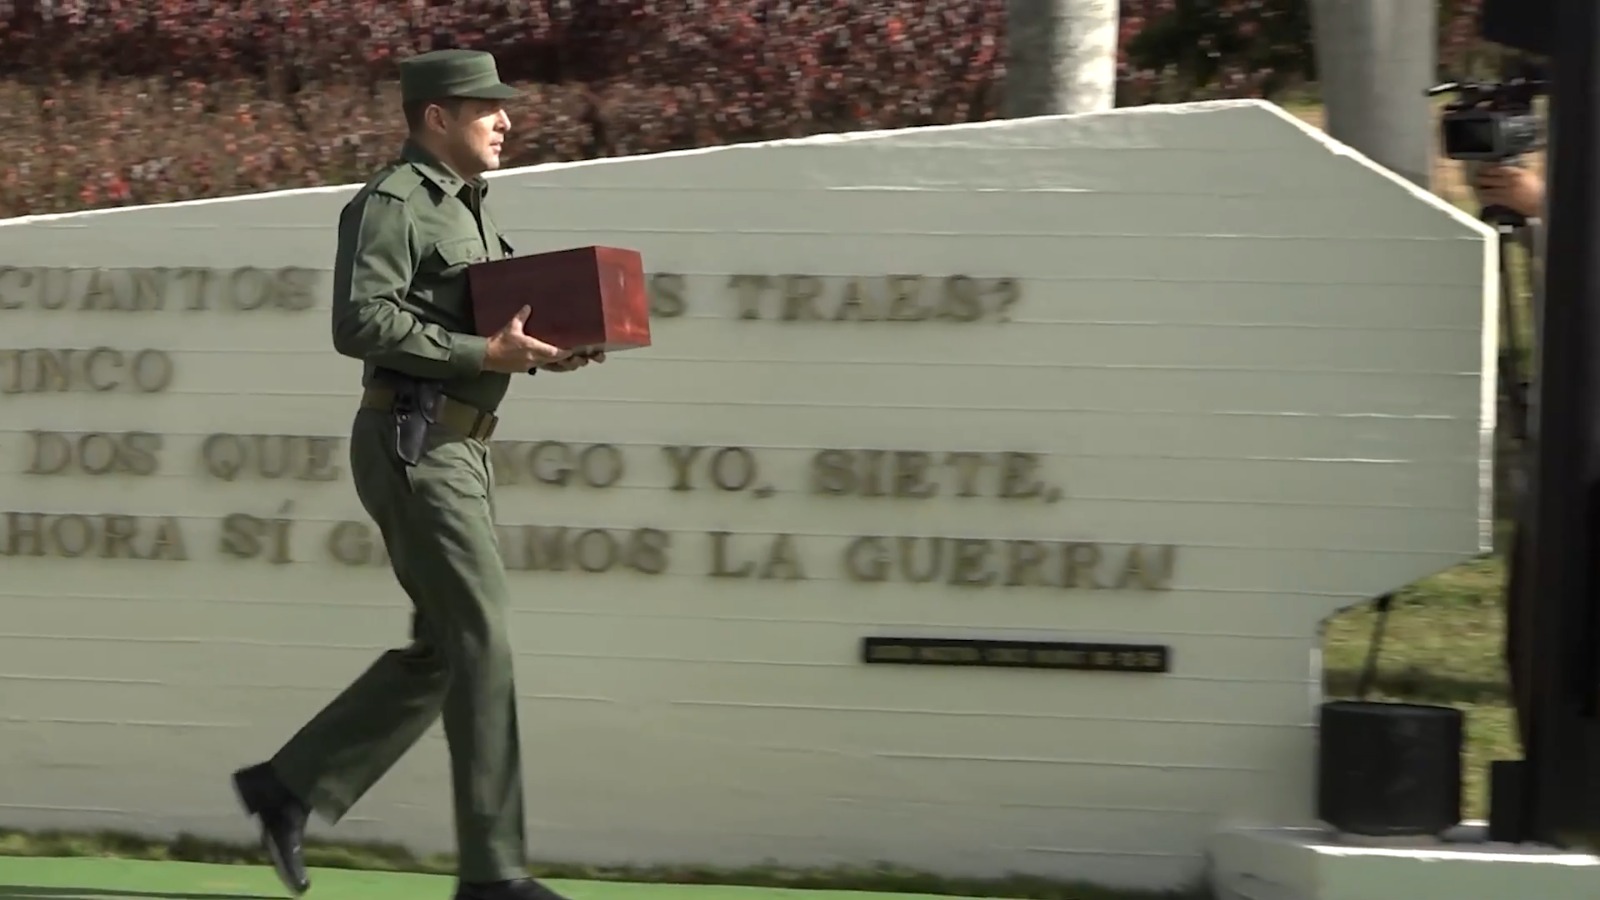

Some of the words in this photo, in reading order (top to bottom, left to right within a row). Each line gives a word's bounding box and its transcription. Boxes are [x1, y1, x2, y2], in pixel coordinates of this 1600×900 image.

[727, 274, 1022, 323] TRAES?
[0, 346, 173, 393] INCO
[23, 430, 163, 476] DOS
[201, 432, 342, 482] QUE
[0, 512, 190, 560] HORA
[706, 531, 807, 580] LA
[842, 536, 1176, 591] GUERRA!
